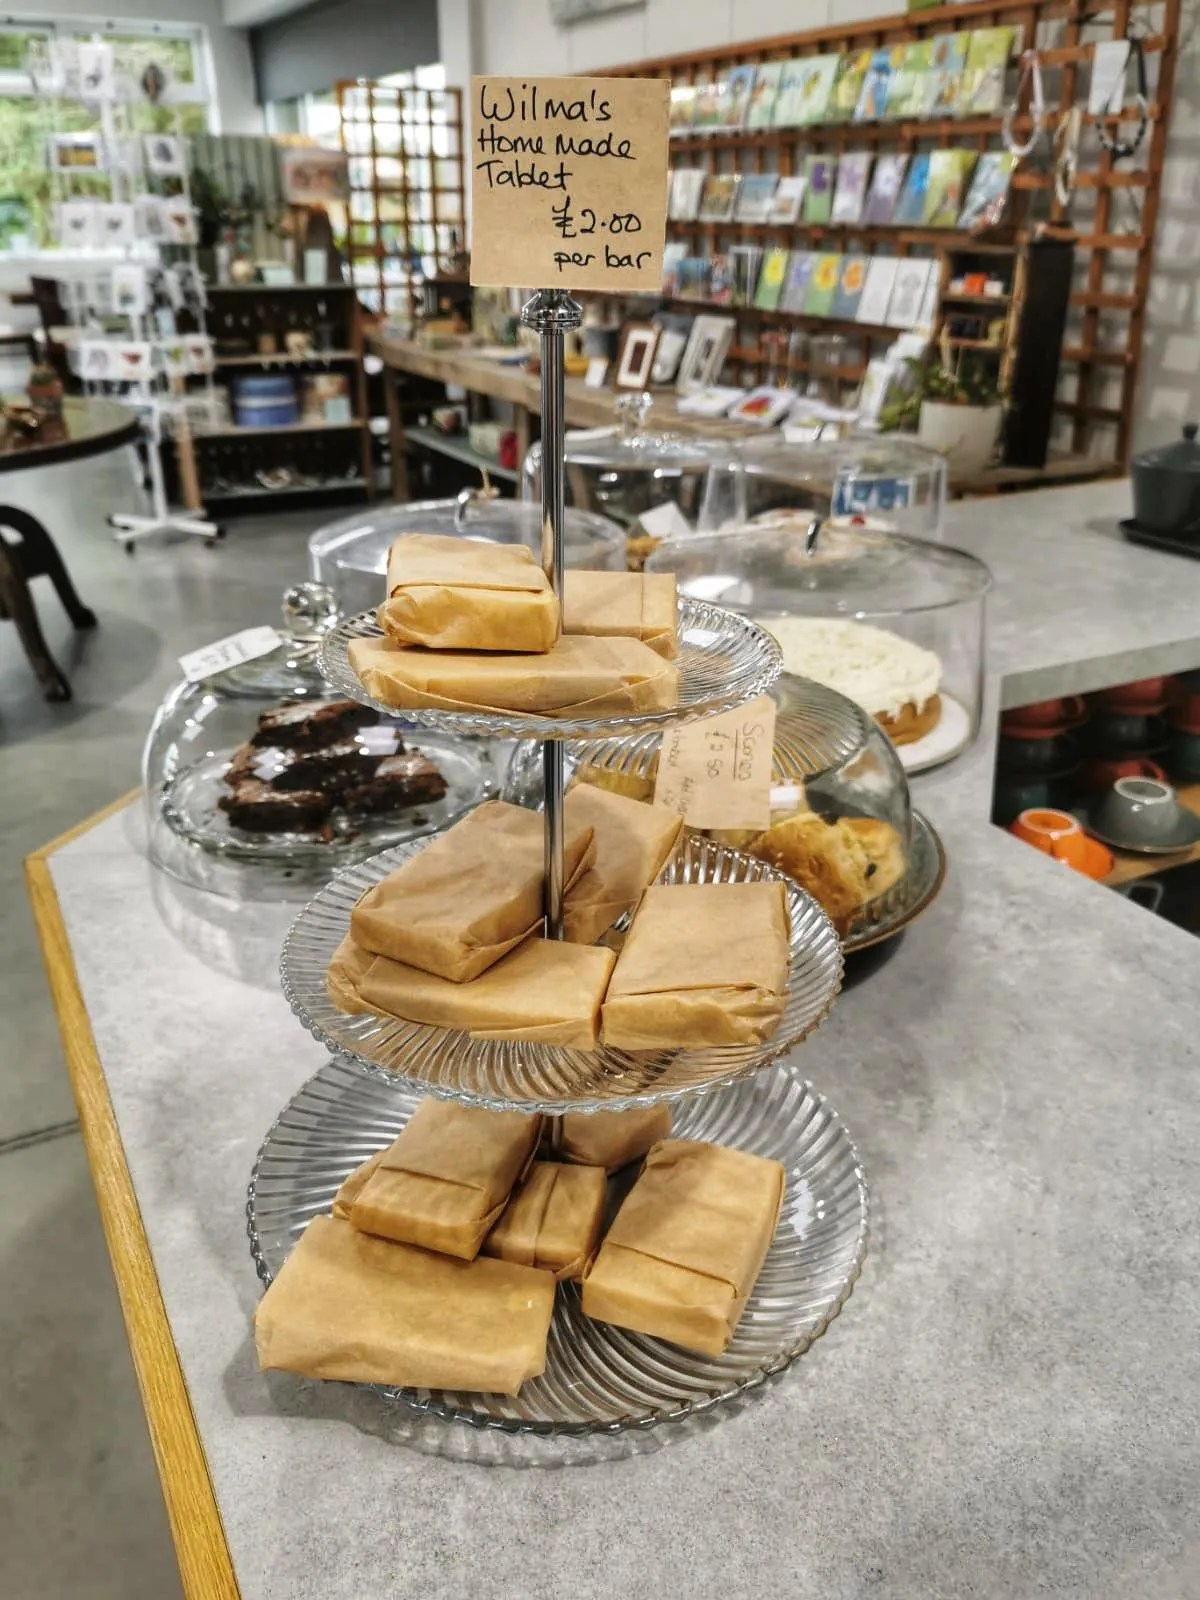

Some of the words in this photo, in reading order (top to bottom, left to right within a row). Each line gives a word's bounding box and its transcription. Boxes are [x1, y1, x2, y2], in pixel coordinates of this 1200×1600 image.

[481, 84, 612, 122] Wilma's
[477, 124, 547, 155] Home
[556, 132, 637, 160] Made
[476, 159, 573, 190] Tablet
[552, 195, 642, 239] £2.00
[553, 251, 596, 272] per
[605, 244, 651, 269] bar
